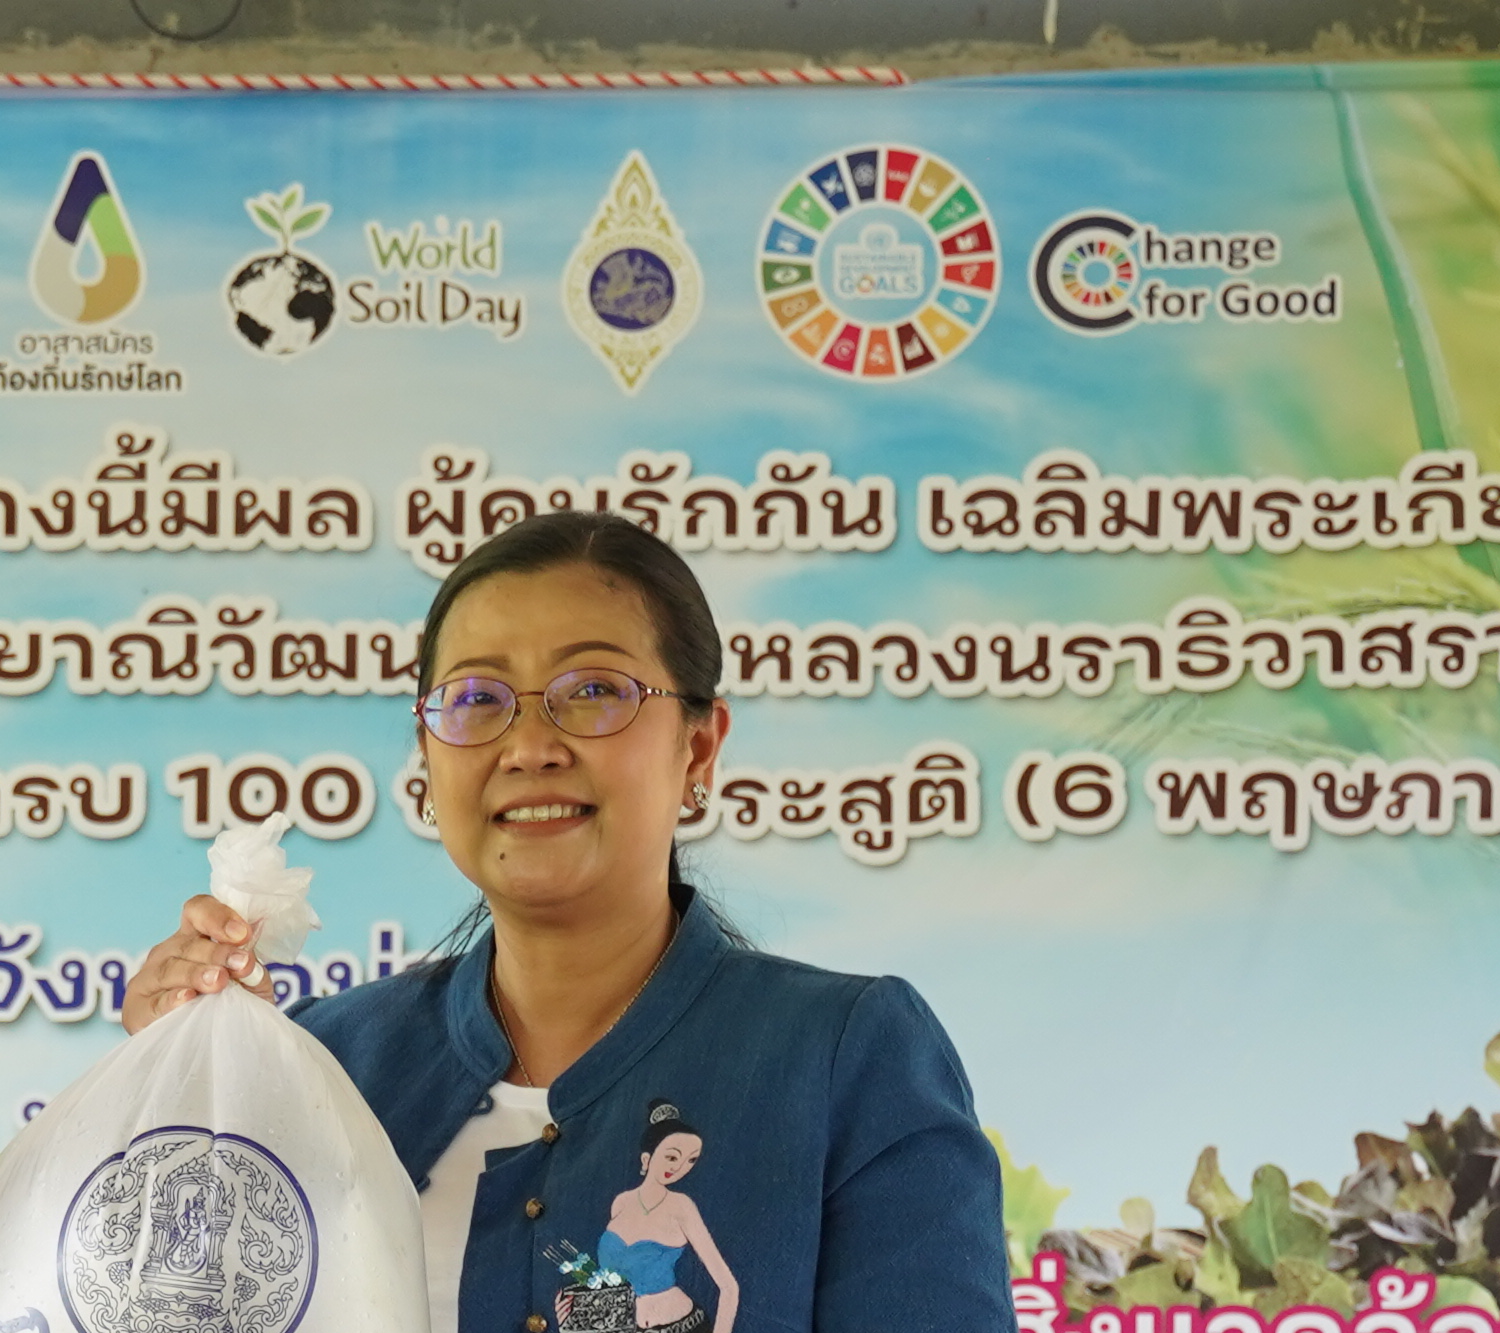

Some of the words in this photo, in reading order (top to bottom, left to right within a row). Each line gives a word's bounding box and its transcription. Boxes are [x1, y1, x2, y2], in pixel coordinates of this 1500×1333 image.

[371, 223, 498, 272] World
[348, 282, 423, 324] Soil
[440, 283, 521, 337] Day
[1146, 283, 1207, 317] for
[1221, 280, 1338, 317] Good
[20, 331, 154, 357] อาสาสมัคร
[177, 765, 362, 825] 100
[679, 753, 967, 852] ระสูติ
